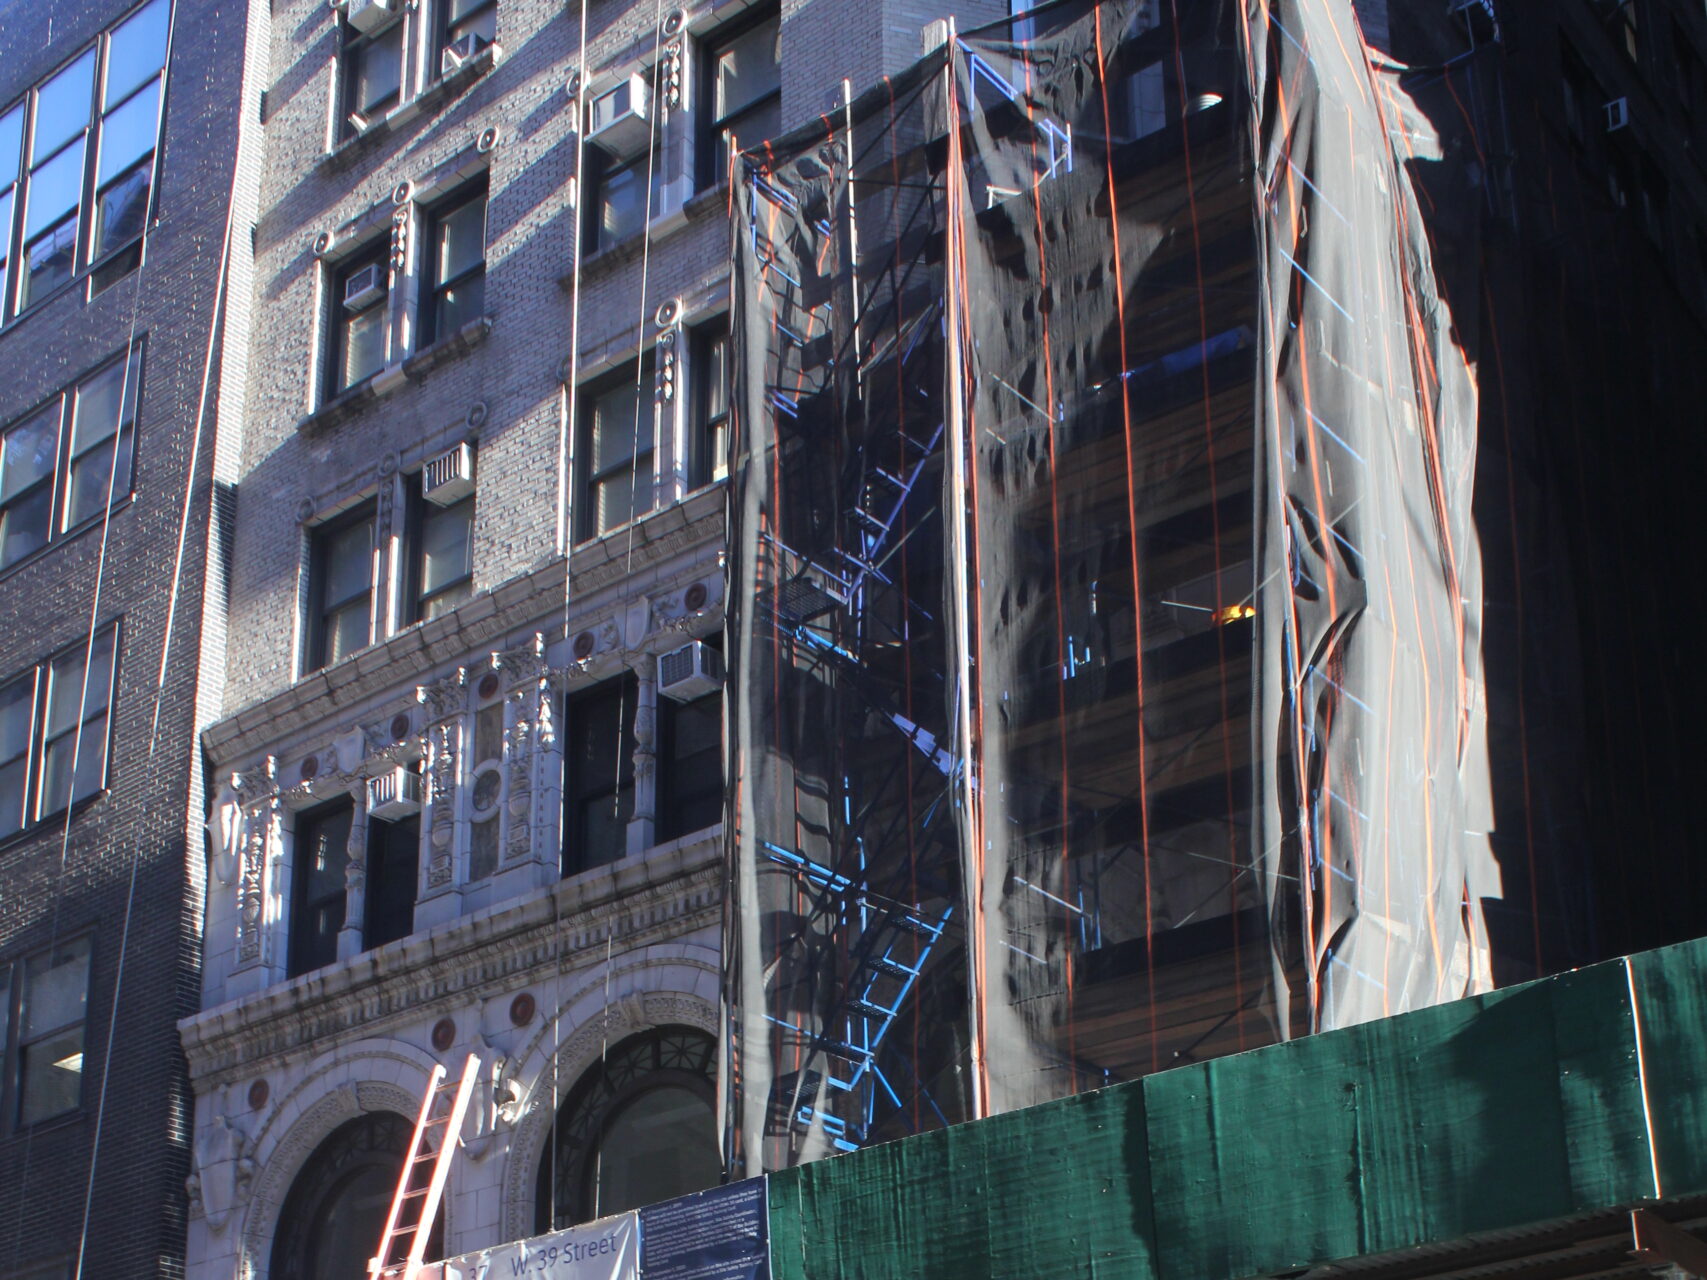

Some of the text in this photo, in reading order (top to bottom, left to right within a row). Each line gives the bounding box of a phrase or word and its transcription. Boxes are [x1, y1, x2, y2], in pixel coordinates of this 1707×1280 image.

[511, 1256, 532, 1278] W.
[537, 1247, 559, 1271] 39
[563, 1235, 618, 1264] Street
